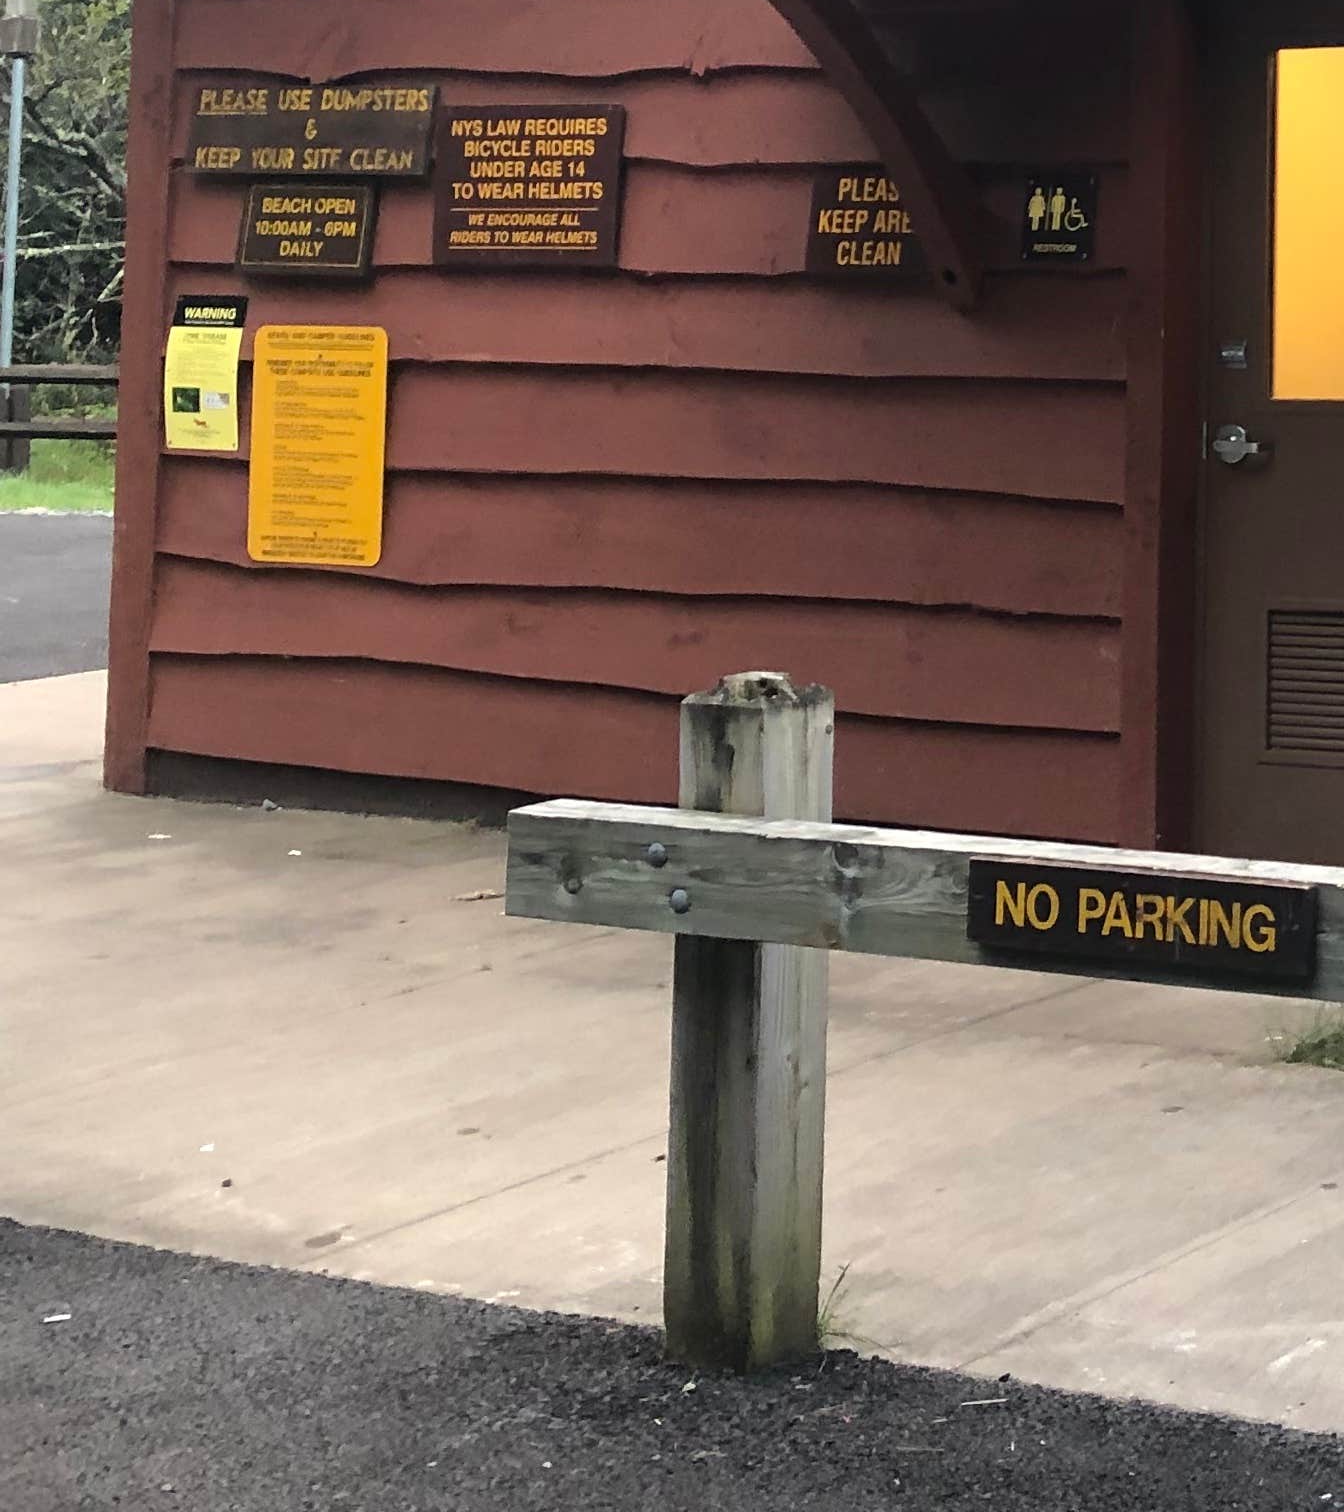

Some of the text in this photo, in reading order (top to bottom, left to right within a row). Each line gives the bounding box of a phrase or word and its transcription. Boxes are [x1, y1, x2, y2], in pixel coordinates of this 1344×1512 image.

[199, 88, 430, 113] PLEASE USE DUMPSTERS
[304, 117, 318, 140] &
[451, 118, 608, 137] NYS LAW REQUIRES
[463, 139, 595, 157] BICYCLE RIDERS
[194, 146, 241, 169] KEEP
[252, 147, 295, 170] YOUR
[350, 148, 414, 171] CLEAN
[469, 160, 585, 178] UNDER AGE 14
[451, 182, 604, 199] TO WEAR HELMETS
[837, 176, 900, 202] PLEAS
[261, 197, 356, 215] BEACH OPEN
[255, 220, 313, 236] 10:00AM
[467, 213, 581, 226] WE ENCOURAGE ALL
[817, 209, 913, 234] KEEP ARE
[449, 231, 598, 245] RIDERS TO WEAR HELMETS
[279, 240, 324, 257] DAILY
[836, 240, 902, 266] CLEAN
[184, 306, 237, 320] WARNING
[994, 879, 1277, 953] NO PARKING
